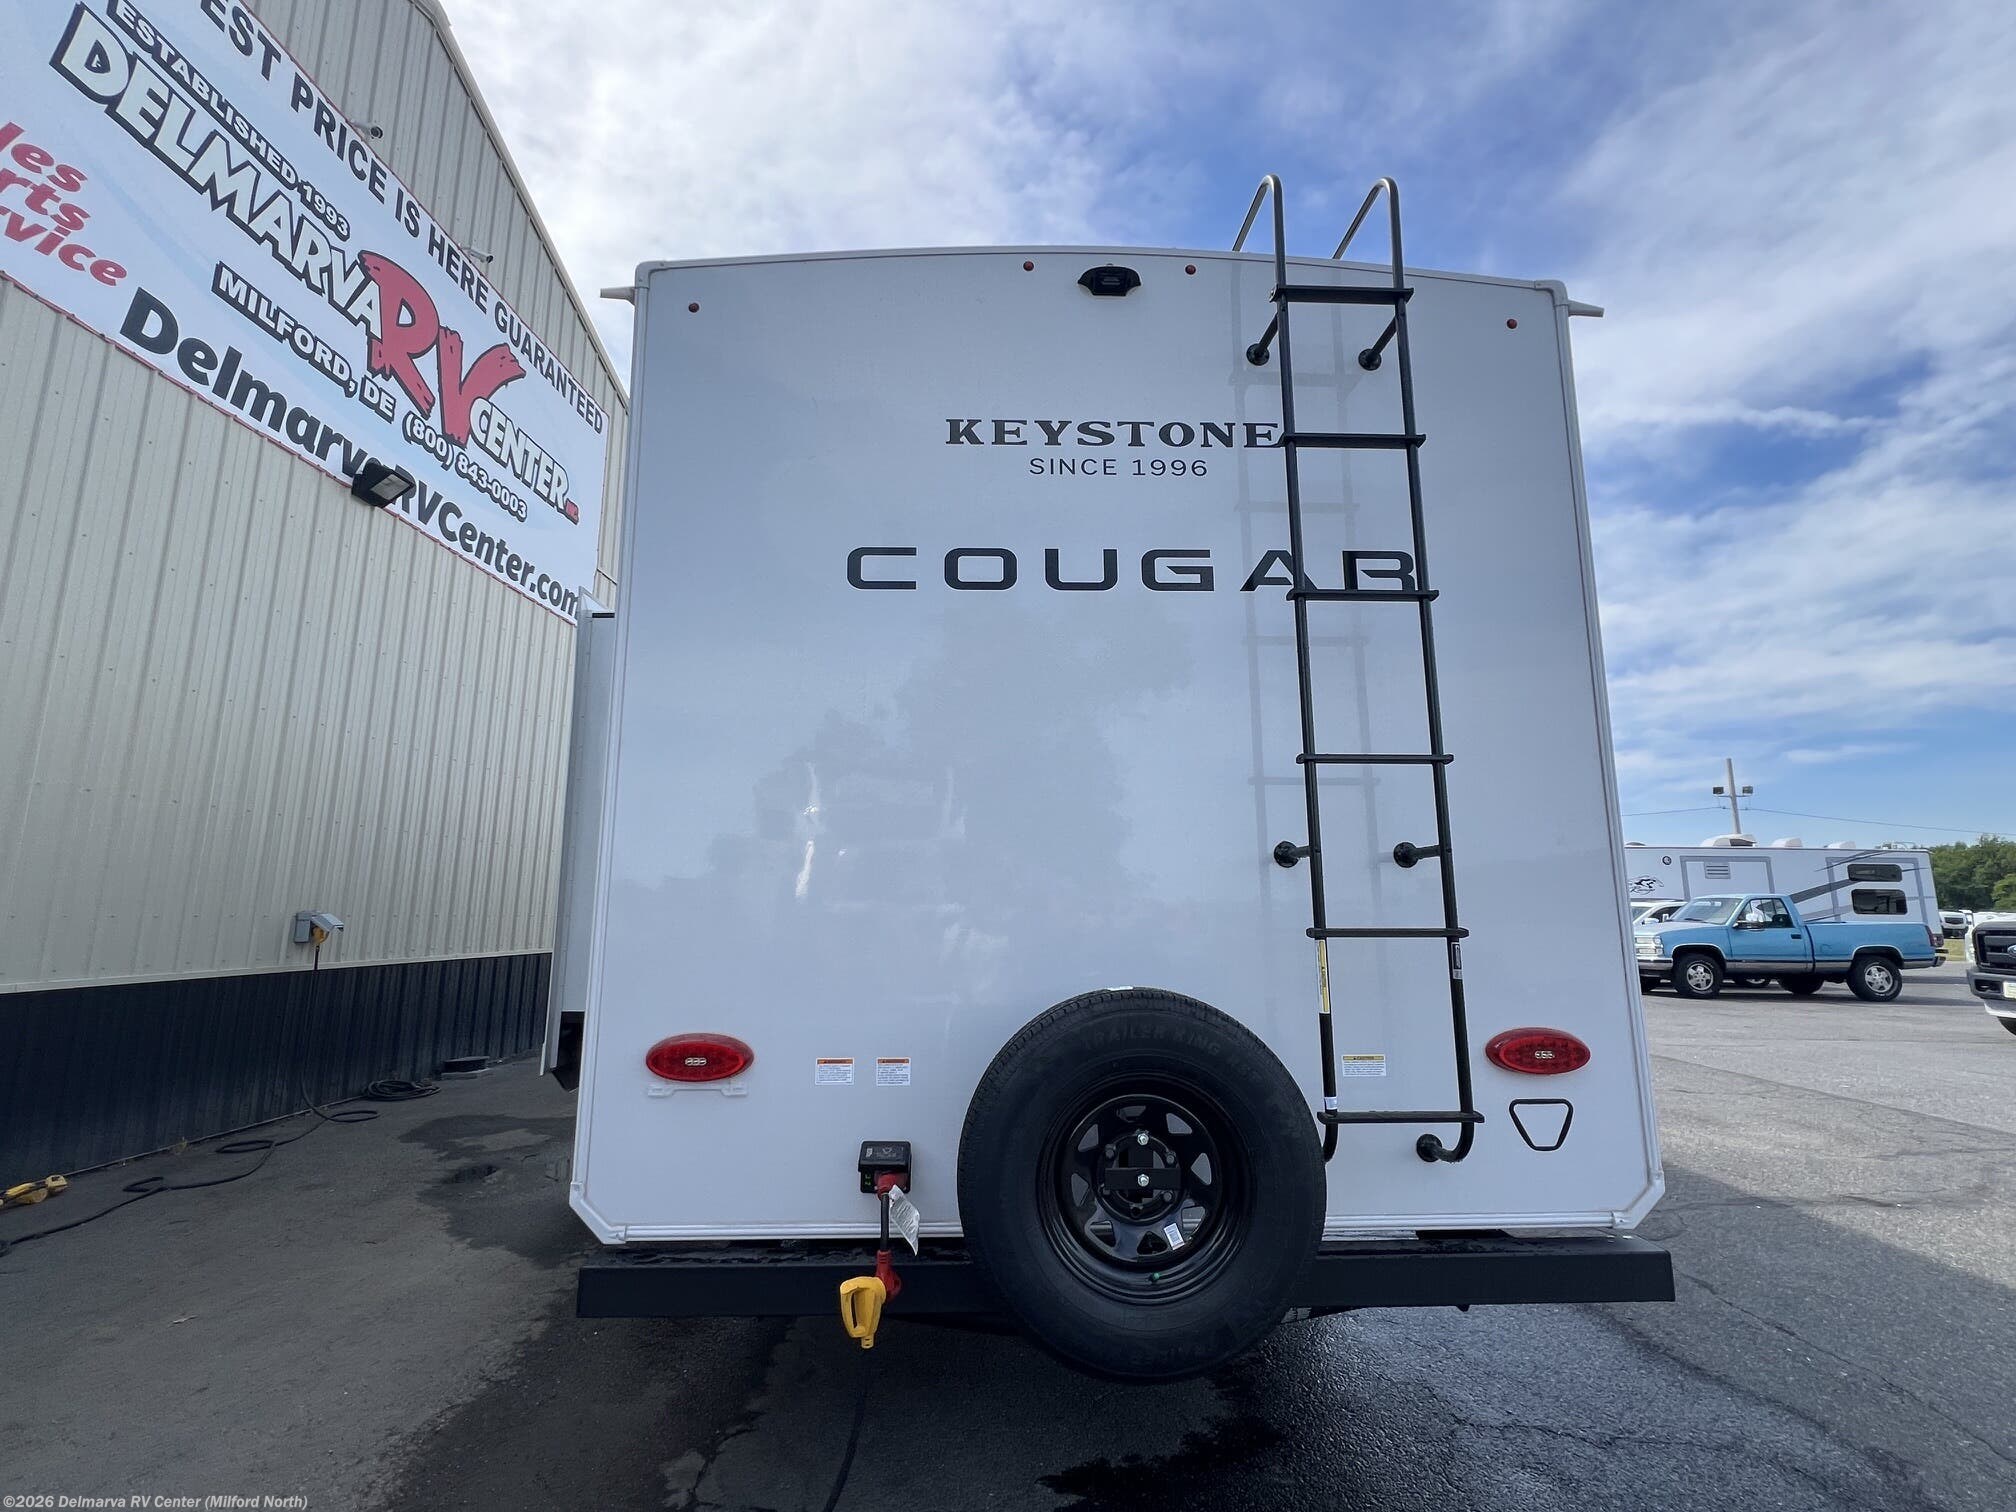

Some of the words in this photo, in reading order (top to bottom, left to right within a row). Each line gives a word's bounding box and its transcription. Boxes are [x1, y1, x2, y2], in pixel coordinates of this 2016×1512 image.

[106, 0, 299, 190] ESTABLISHED
[298, 180, 350, 242] 1993
[0, 205, 127, 286] vice
[49, 2, 383, 345] DELMARVA
[357, 250, 527, 450] RV
[470, 396, 569, 513] CENTER
[291, 72, 387, 205] PRICE
[395, 188, 420, 238] IS
[428, 226, 488, 315] HERE
[494, 301, 602, 434] GUARANTEED
[120, 287, 578, 619] DelmarvRVCenter.com
[211, 261, 358, 398] MILFORD,
[359, 375, 396, 424] DE
[402, 411, 454, 470] (800)
[455, 452, 528, 523] 843-0003
[945, 419, 1284, 448] KEYSTONE
[1029, 458, 1118, 475] SINCE
[1132, 459, 1208, 477] 1996
[847, 547, 1415, 592] COUGAR
